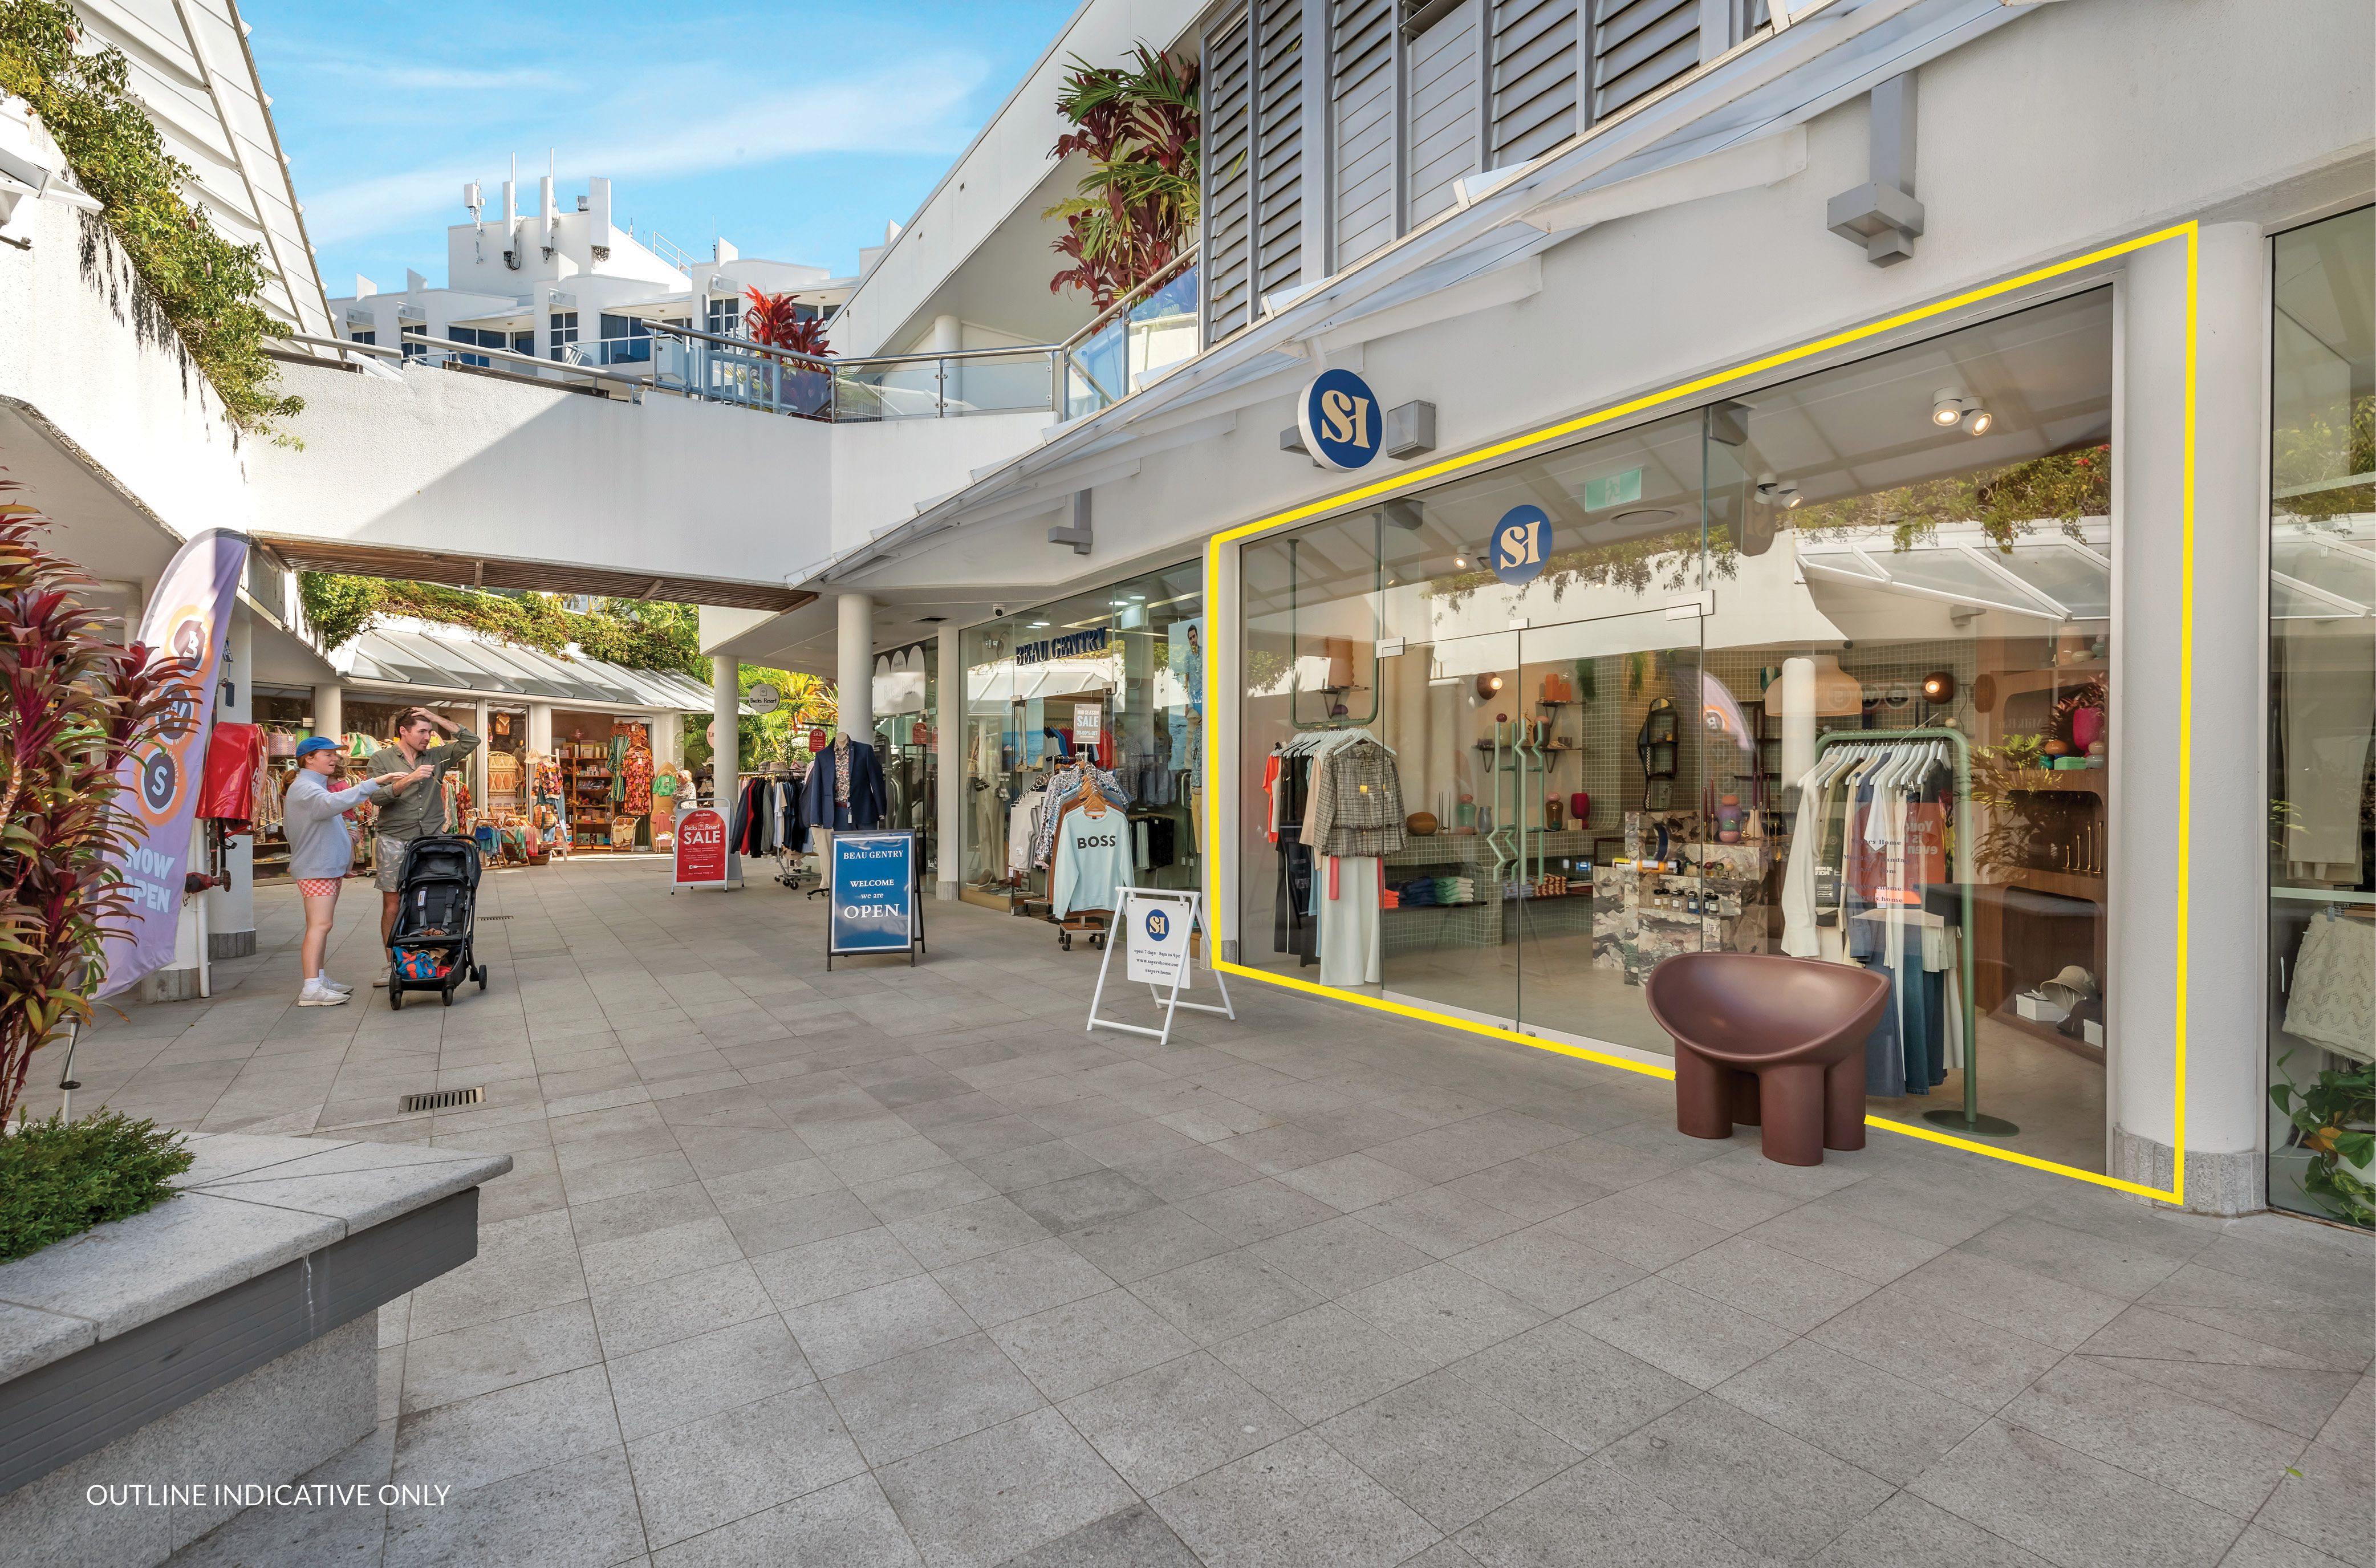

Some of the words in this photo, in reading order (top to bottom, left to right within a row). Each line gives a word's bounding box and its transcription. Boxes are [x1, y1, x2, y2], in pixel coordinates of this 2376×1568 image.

[184, 630, 199, 661] B
[1016, 640, 1050, 666] BEAU
[1051, 626, 1107, 659] GENTRY
[1077, 715, 1099, 727] SALE
[152, 766, 168, 796] S
[684, 830, 721, 845] SALE
[1077, 835, 1116, 850] BOSS
[125, 842, 176, 880] NOW
[869, 850, 904, 859] GENTRY
[850, 879, 895, 888] WELCOME
[117, 875, 171, 913] OPEN
[844, 904, 900, 919] OPEN
